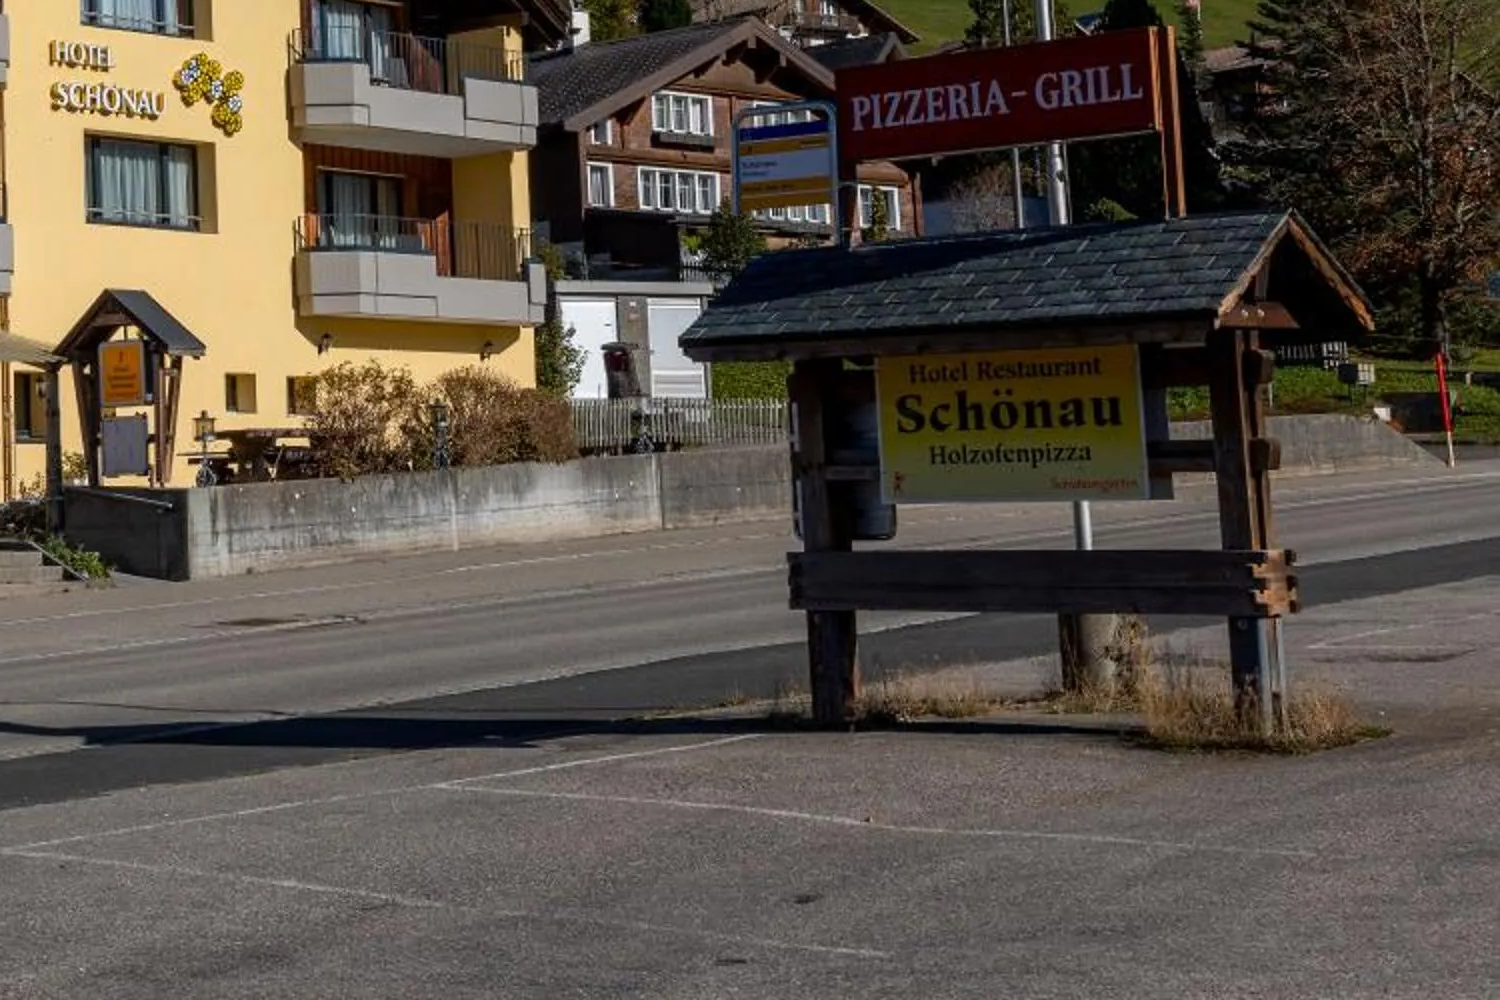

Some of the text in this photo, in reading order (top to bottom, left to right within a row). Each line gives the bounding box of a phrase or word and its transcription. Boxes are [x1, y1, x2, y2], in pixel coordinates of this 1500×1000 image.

[51, 40, 116, 70] HOTEL
[851, 79, 1010, 131] PIZZERIA
[1035, 63, 1144, 110] GRILL
[909, 357, 1103, 384] Hotel Restaurant
[896, 389, 1123, 433] Schönau
[929, 442, 1093, 468] Holzofenpizza
